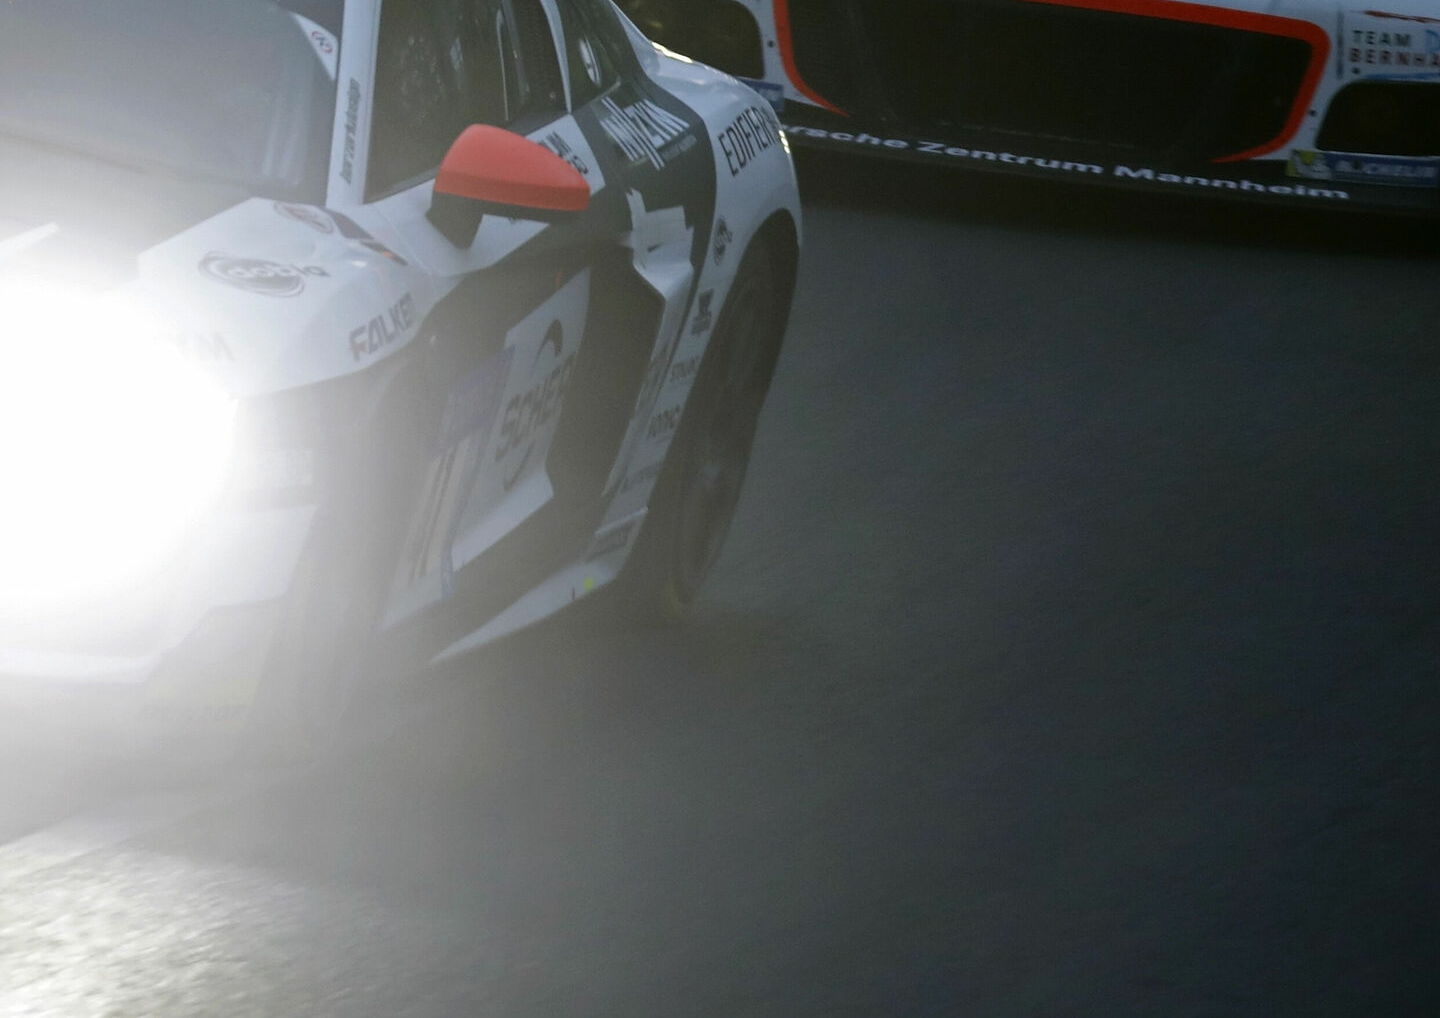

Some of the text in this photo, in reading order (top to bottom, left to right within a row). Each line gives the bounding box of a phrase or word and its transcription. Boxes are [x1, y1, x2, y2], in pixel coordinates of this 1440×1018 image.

[1352, 29, 1411, 48] TEAM
[782, 123, 1350, 201] rsche Zentrum Mannheim
[348, 292, 417, 363] FALKE
